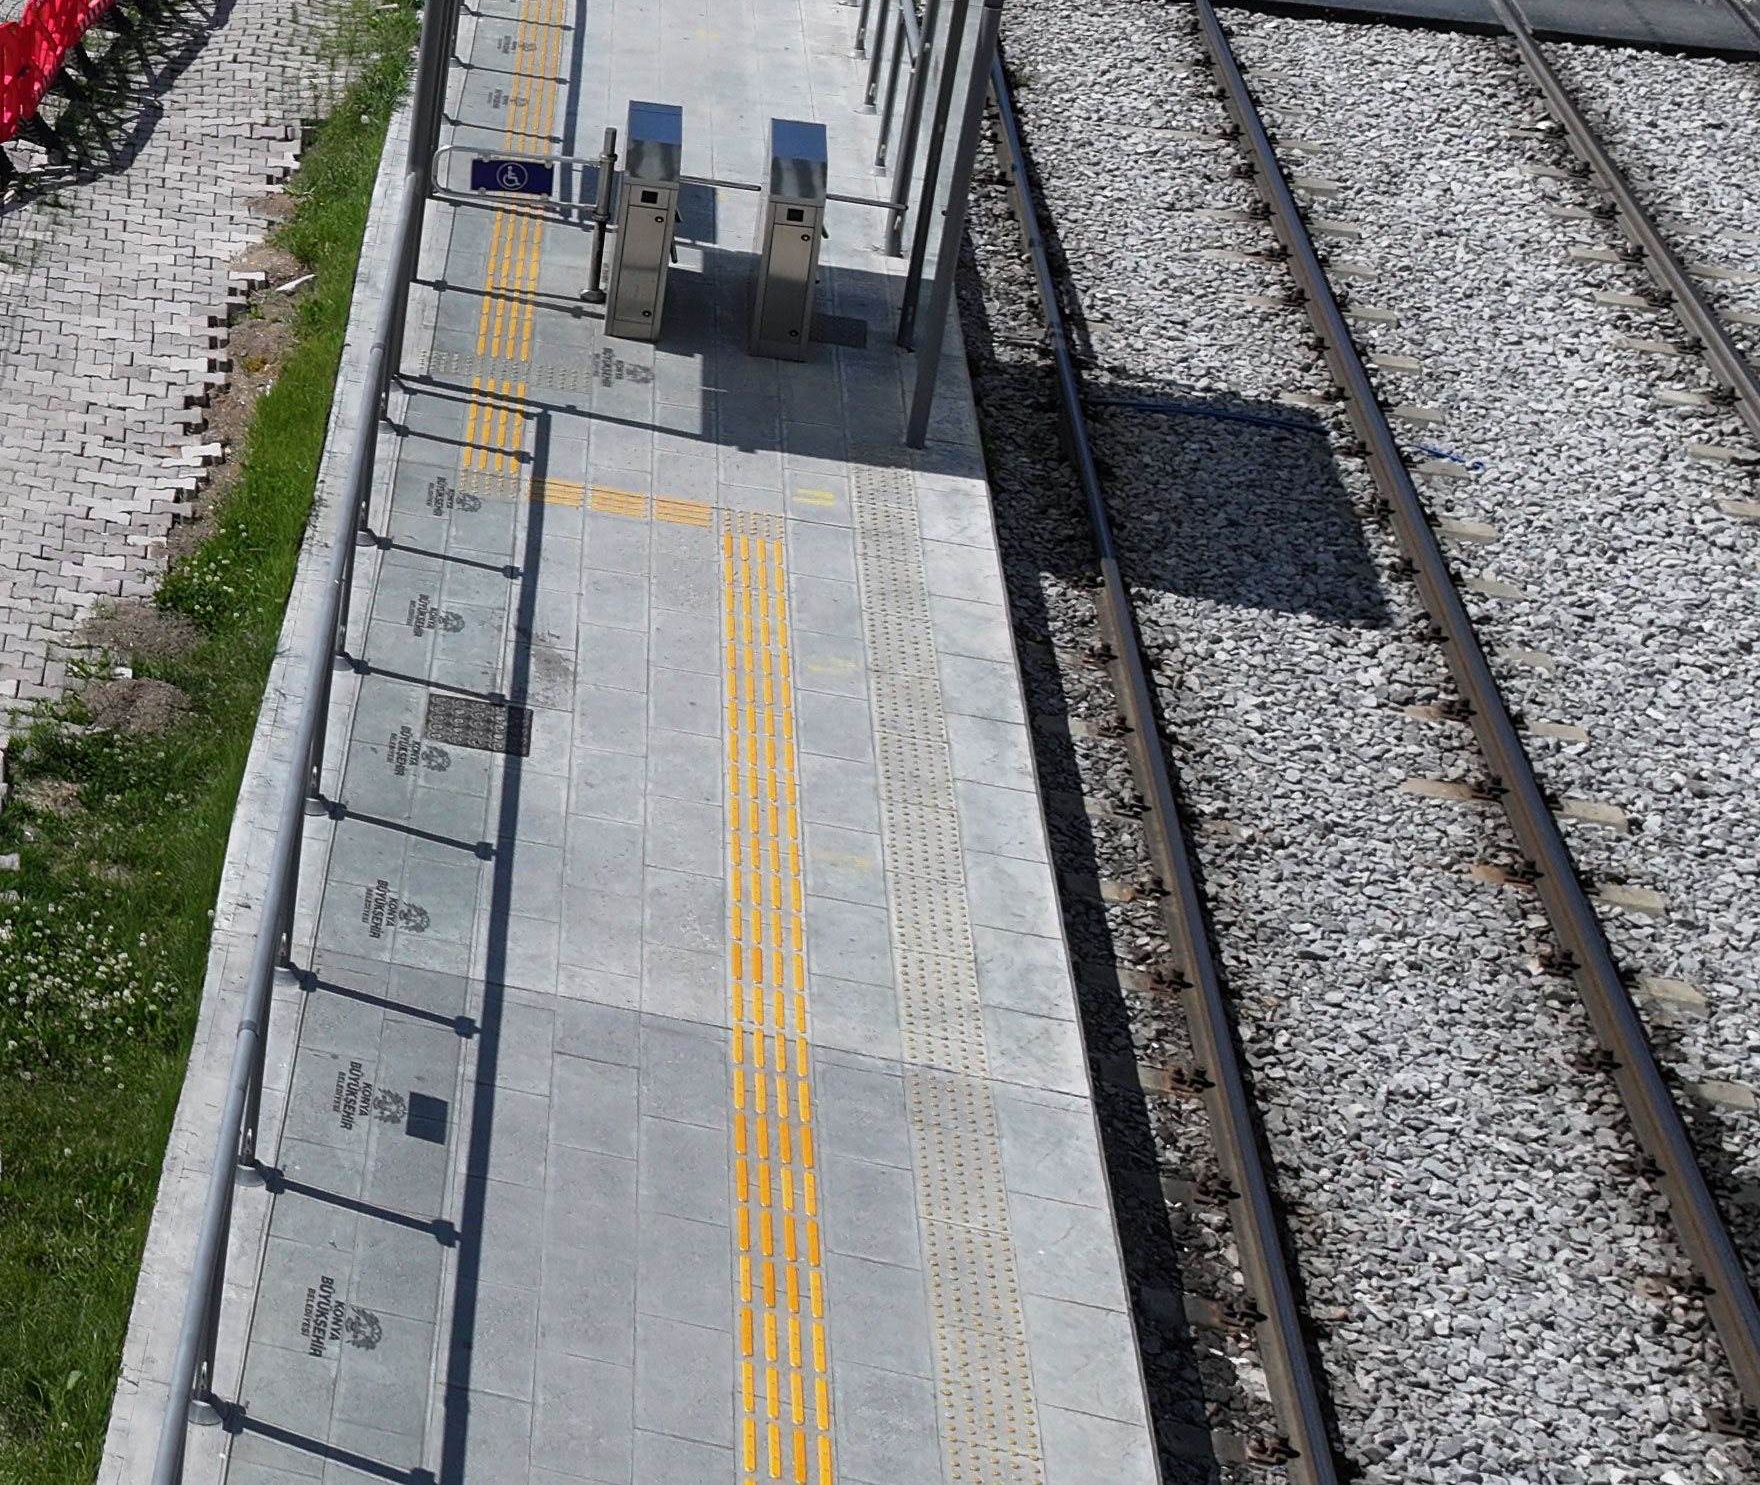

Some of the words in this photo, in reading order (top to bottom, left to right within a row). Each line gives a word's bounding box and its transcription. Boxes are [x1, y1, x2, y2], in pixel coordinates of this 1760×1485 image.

[409, 740, 421, 766] KONYA
[369, 879, 391, 939] BÜYÜKŞEHİR
[386, 897, 400, 927] KONYA
[340, 1060, 364, 1131] BÜYÜKŞEHİR
[358, 1082, 373, 1117] KONYA
[301, 1287, 316, 1338] BELEDİYESİ
[308, 1275, 336, 1358] BÜYÜKŞEHİR
[328, 1300, 346, 1341] KONYA
